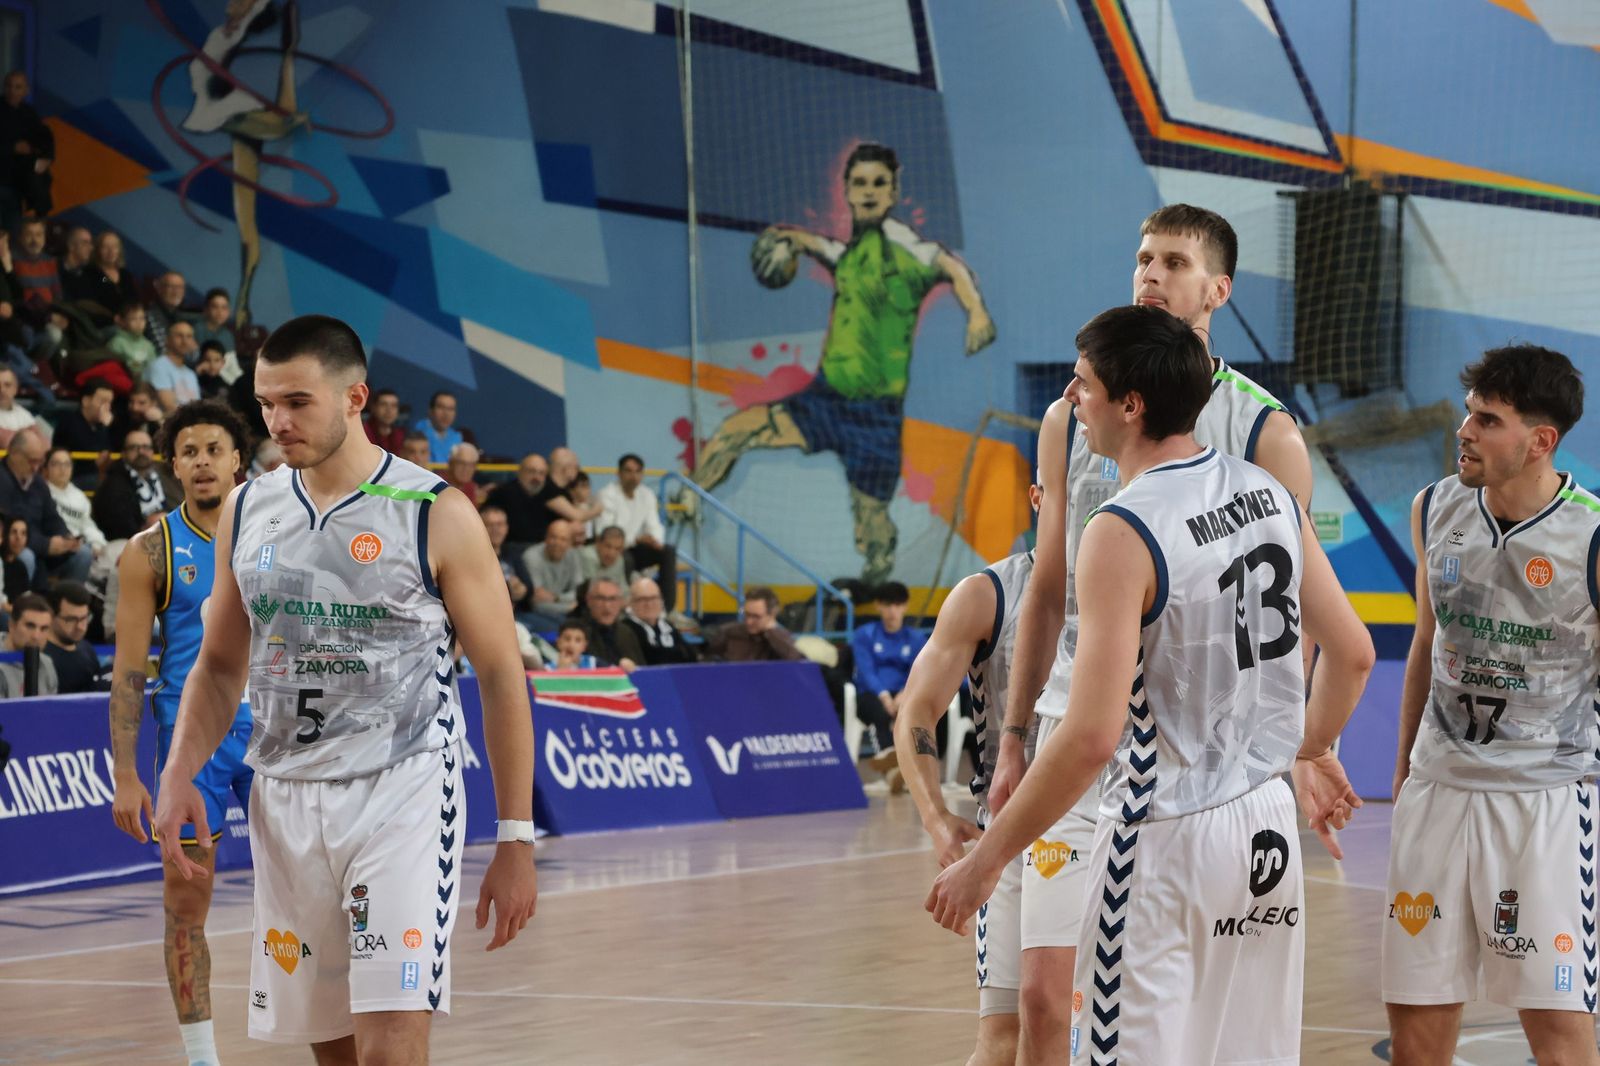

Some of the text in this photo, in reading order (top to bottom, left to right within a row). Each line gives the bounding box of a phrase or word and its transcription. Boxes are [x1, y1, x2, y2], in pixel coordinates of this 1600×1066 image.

[1185, 488, 1281, 547] MARTÍNEZ
[284, 600, 393, 619] CAJA RURAL
[1218, 543, 1300, 671] 13
[302, 617, 374, 628] DE ZAMORA
[1459, 613, 1556, 641] CAJA RURAL
[1472, 629, 1537, 648] DE ZAMORA
[294, 660, 370, 675] ZAMORA
[1460, 670, 1529, 691] ZAMORA
[296, 688, 325, 744] 5
[1457, 693, 1507, 745] 17
[564, 723, 679, 749] LÁCTEAS
[0, 747, 115, 819] LIMERK
[1026, 848, 1079, 866] ZAMORA
[1213, 905, 1299, 938] MOLEJO
[1389, 903, 1441, 920] ZAMORA
[263, 940, 312, 958] ZAMORA
[354, 933, 388, 952] ORA
[1483, 931, 1538, 953] ZAMORA
